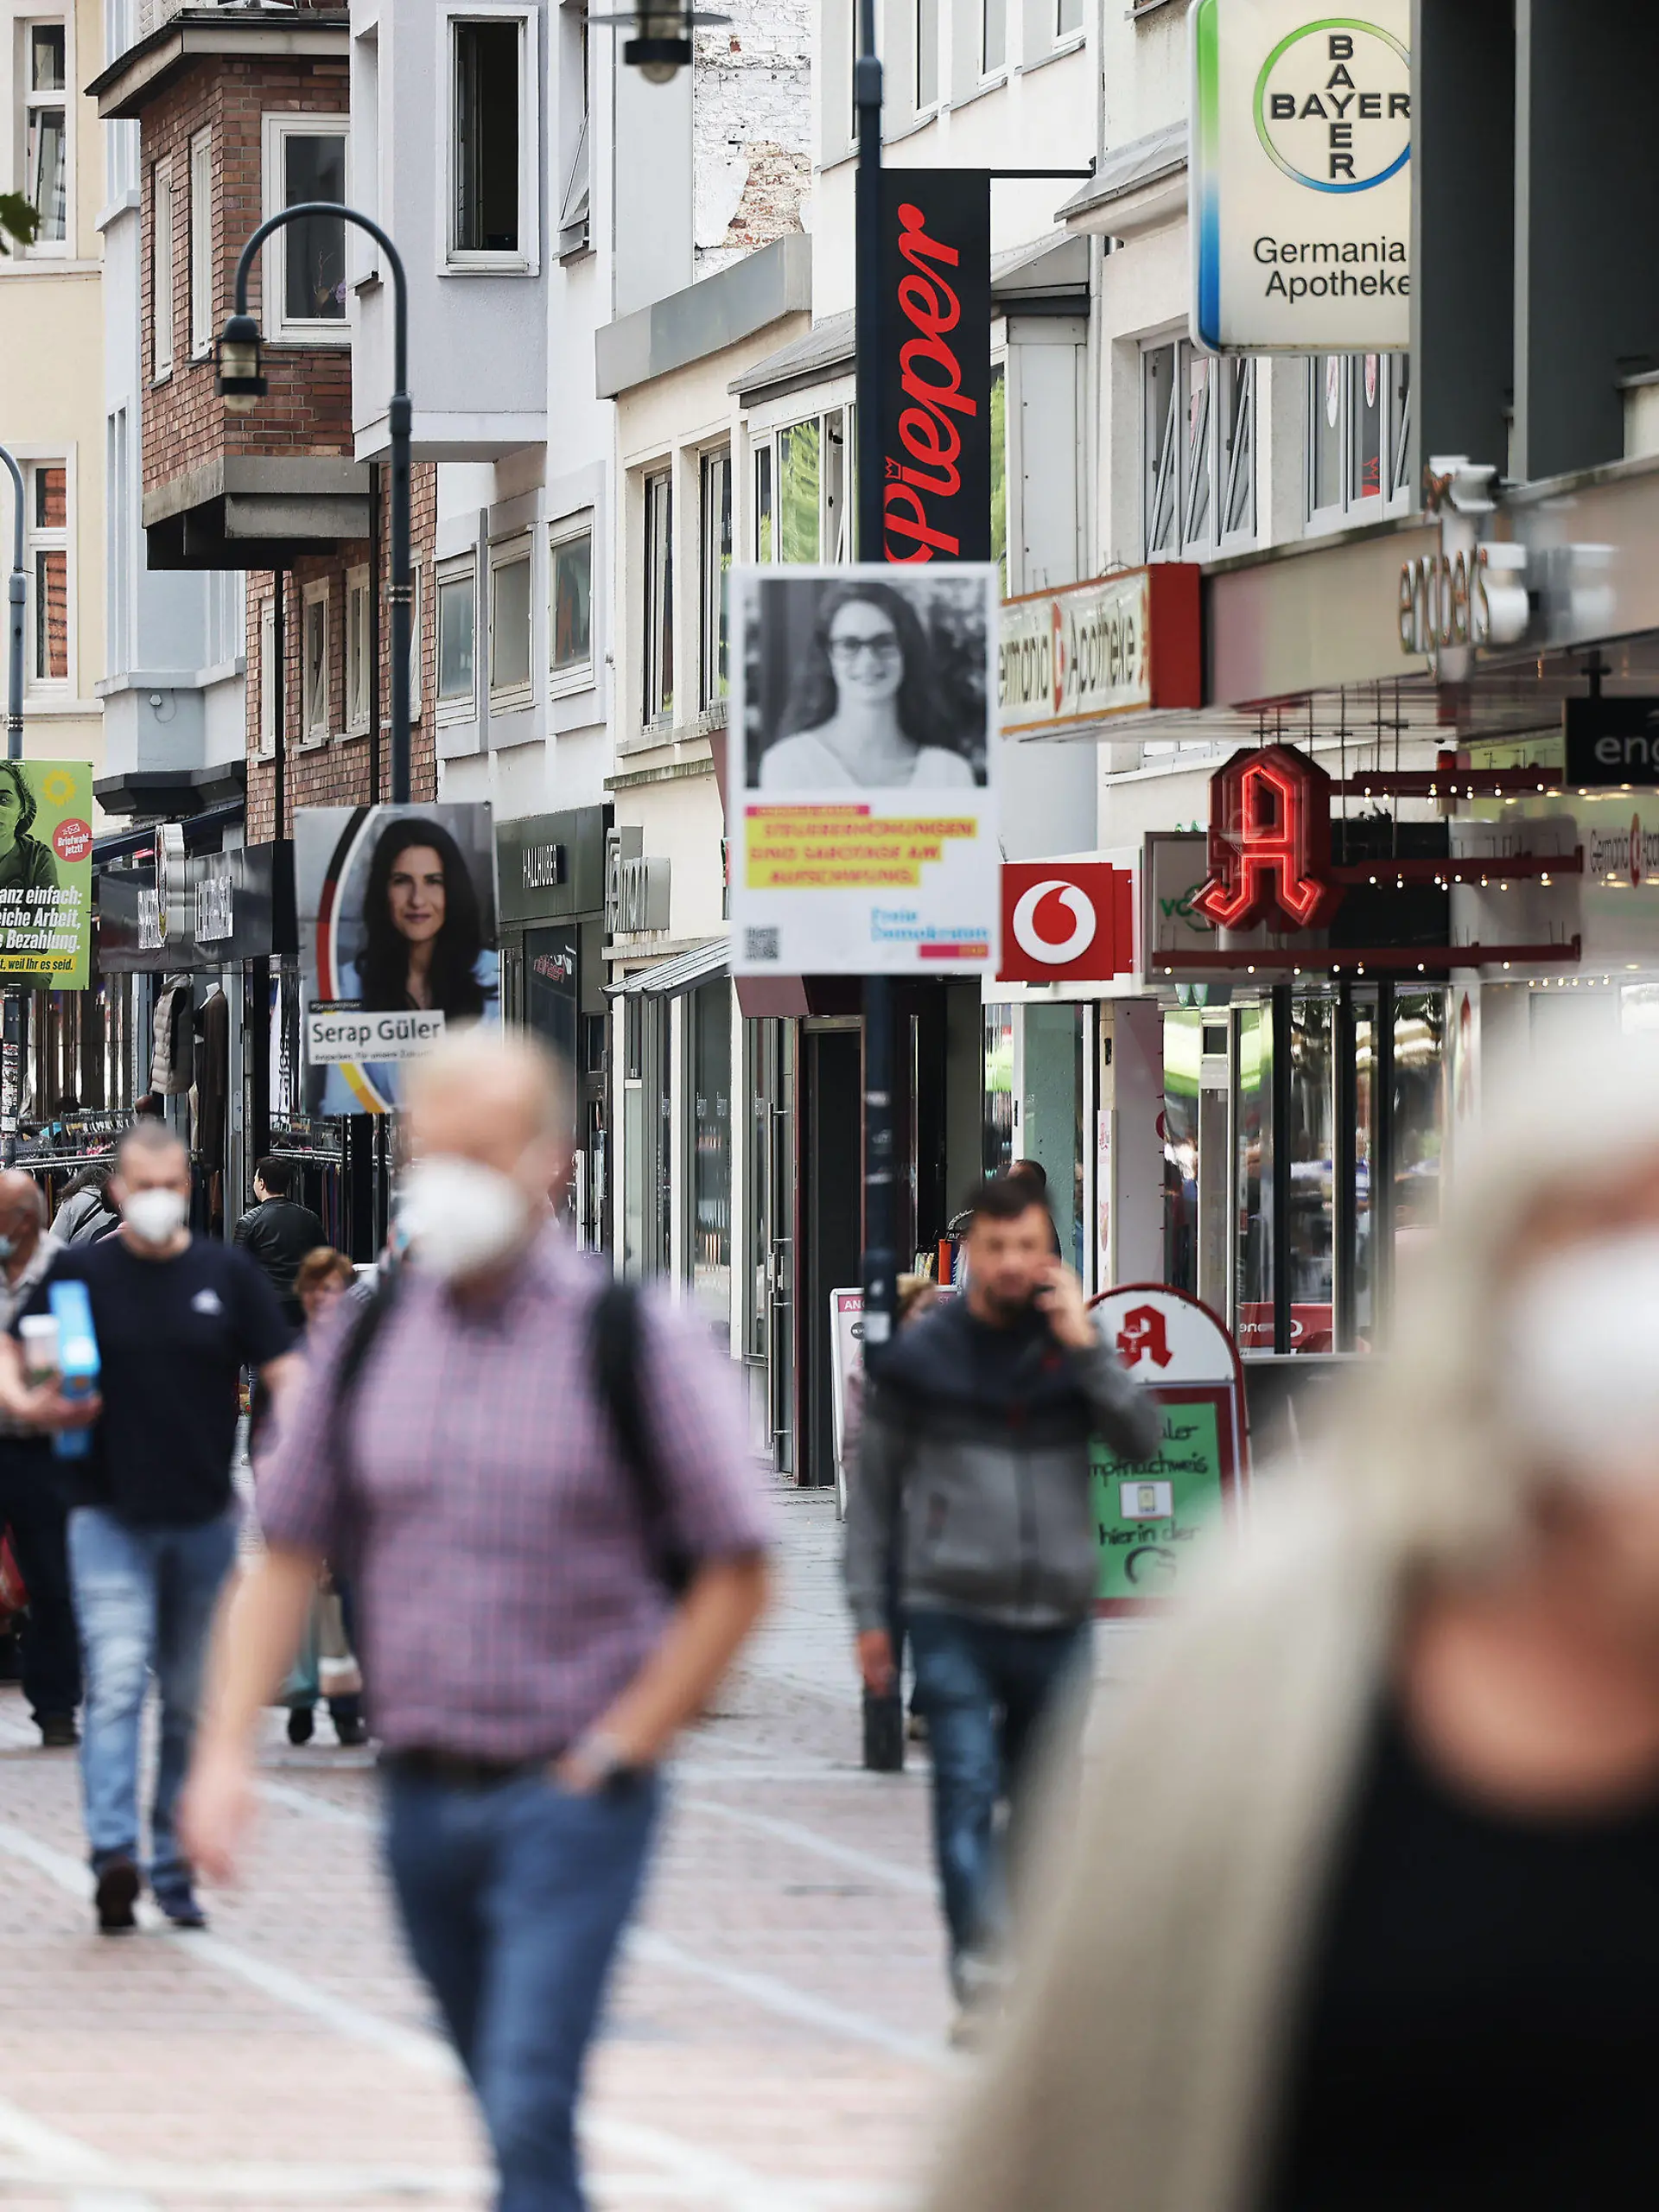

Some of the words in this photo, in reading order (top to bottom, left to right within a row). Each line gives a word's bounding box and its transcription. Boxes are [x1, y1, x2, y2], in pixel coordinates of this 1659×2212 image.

[1270, 93, 1410, 119] BAYER
[1253, 235, 1407, 264] Germania
[1265, 270, 1410, 303] Apotheke
[883, 202, 977, 564] Pieper
[26, 884, 83, 906] einfach:
[0, 906, 31, 927] iche
[33, 906, 81, 930] Arbeit,
[6, 928, 81, 954] Bezahlung.
[8, 958, 25, 970] weil
[26, 957, 39, 969] Ihr
[41, 960, 51, 970] es
[52, 958, 73, 970] seid.
[313, 1022, 372, 1047] Serap
[378, 1017, 442, 1041] Güler
